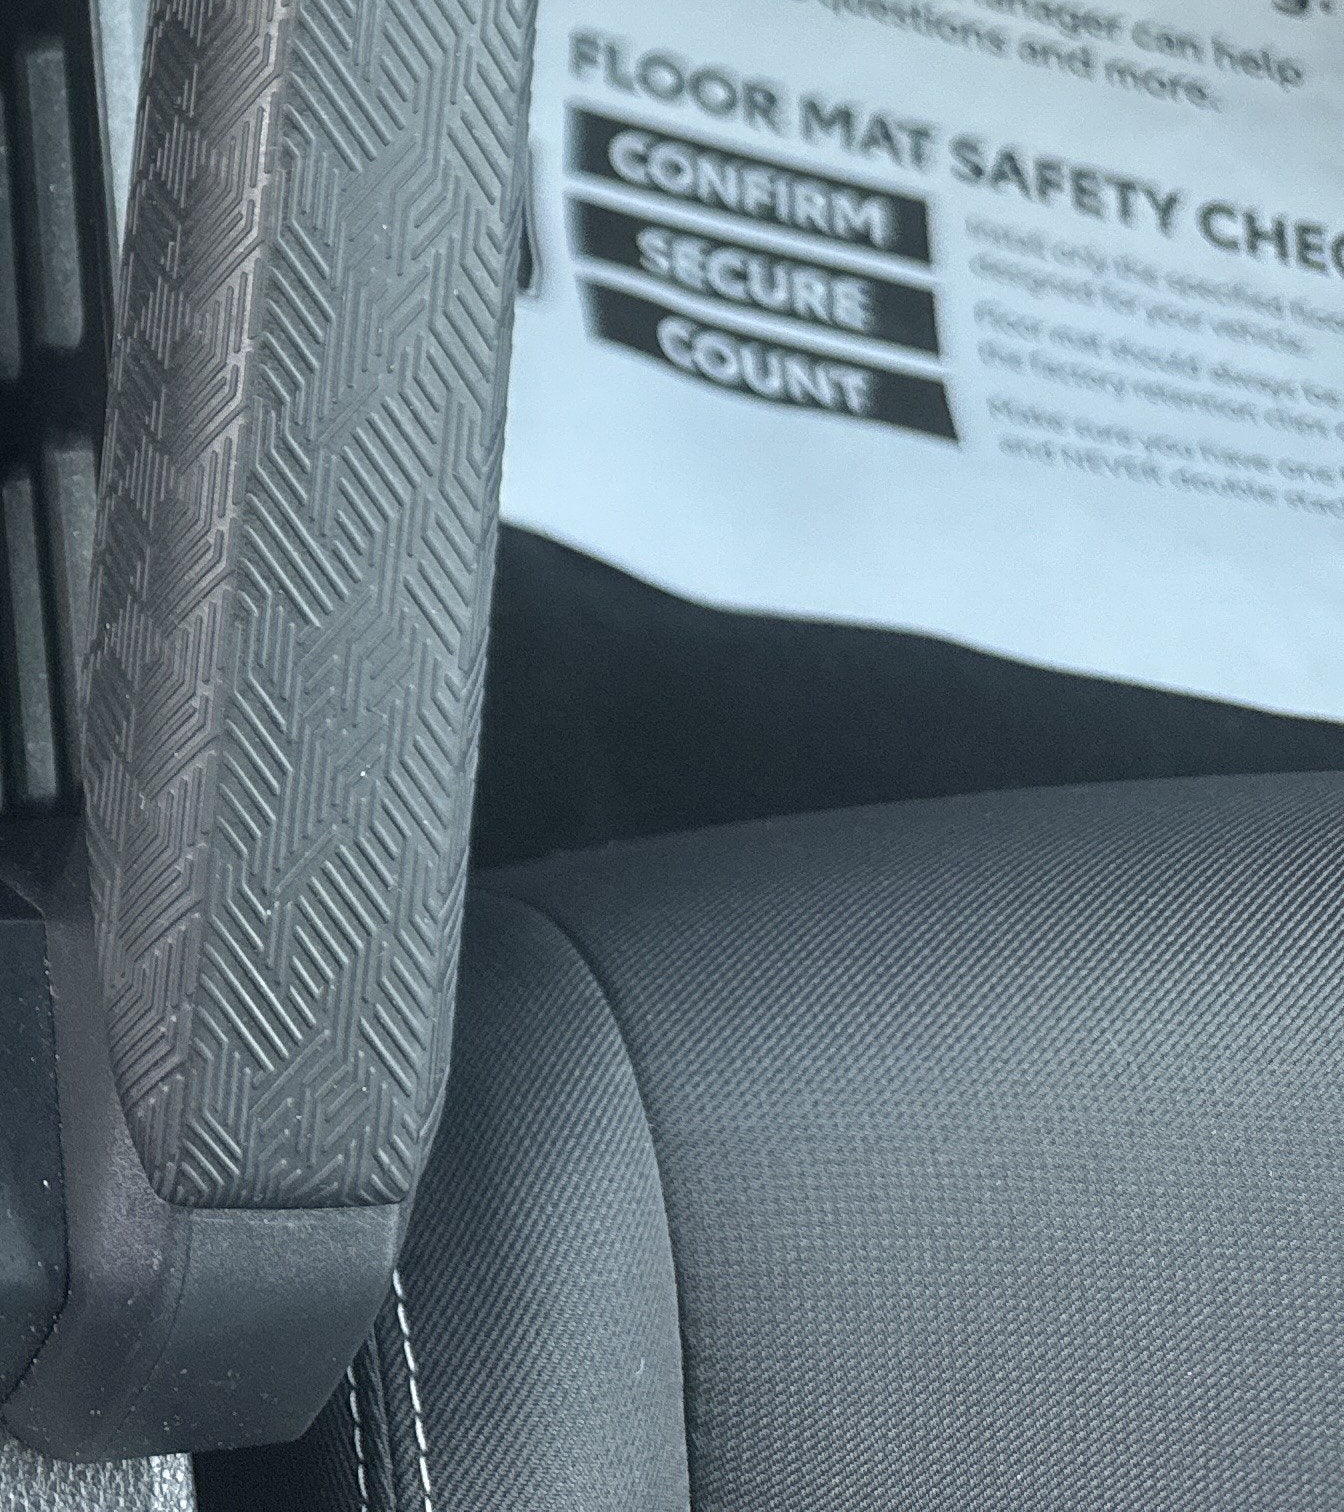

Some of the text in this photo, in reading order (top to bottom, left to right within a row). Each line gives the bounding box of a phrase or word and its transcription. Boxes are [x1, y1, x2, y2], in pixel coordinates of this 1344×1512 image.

[1017, 30, 1097, 80] and
[1131, 19, 1205, 63] can
[1212, 31, 1305, 91] help
[569, 26, 786, 137] FLOOR
[797, 91, 934, 172] MAT
[948, 129, 1183, 238] SAFETY
[606, 128, 893, 253] CONFIRM
[636, 226, 873, 334] SECURE
[656, 315, 874, 418] COUNT
